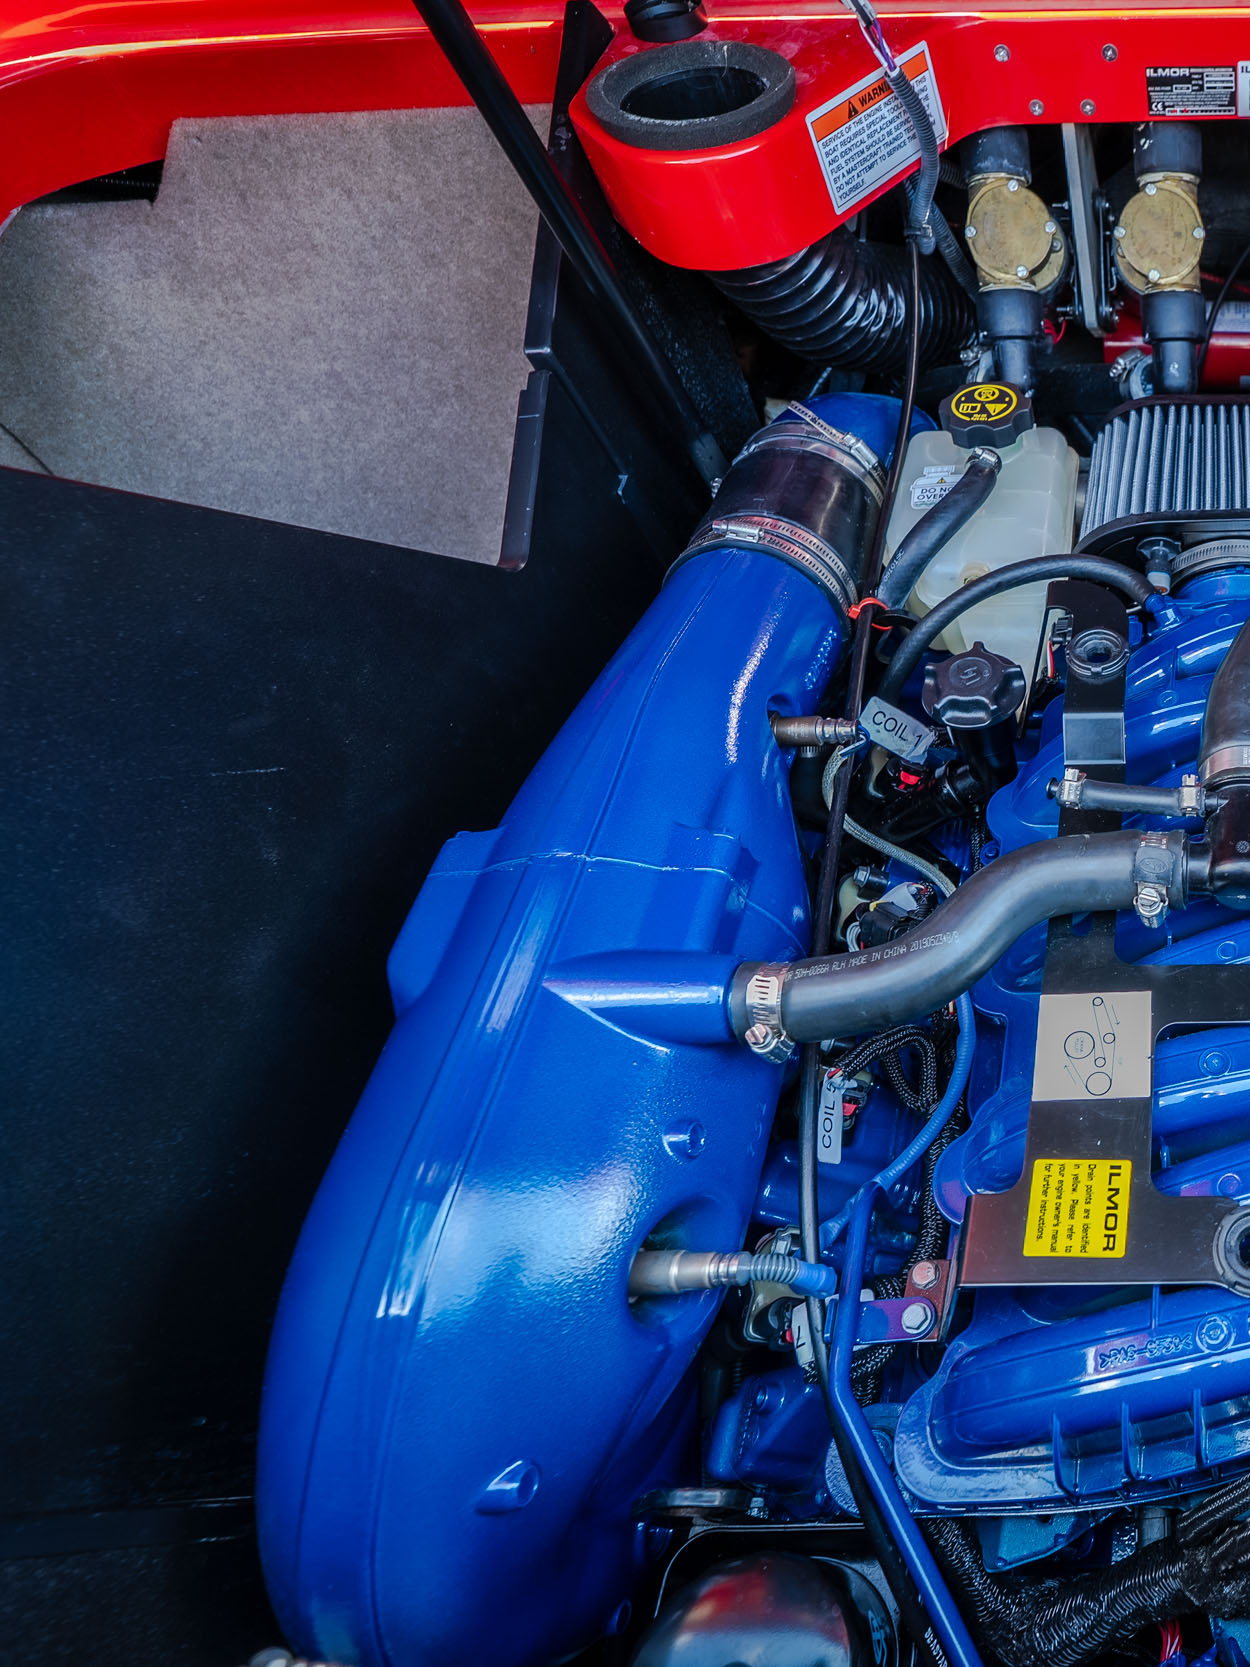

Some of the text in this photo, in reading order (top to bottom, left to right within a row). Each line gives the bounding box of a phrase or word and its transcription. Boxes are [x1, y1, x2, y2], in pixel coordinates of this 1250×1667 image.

[915, 75, 926, 87] THIS
[1146, 68, 1190, 77] ILMOR
[858, 79, 890, 107] WARNI
[821, 129, 844, 149] SERVICE
[844, 123, 853, 134] OF
[852, 117, 863, 128] THE
[863, 103, 883, 121] ENGINE
[824, 143, 839, 158] BOAT
[839, 125, 865, 148] REQUIRES
[865, 112, 886, 130] SPECIAL
[827, 154, 839, 167] AND
[839, 136, 865, 159] IDENTICAL
[866, 112, 901, 140] REPLACEMENT
[830, 162, 844, 176] FUEL
[844, 147, 865, 166] SYSTEM
[865, 134, 885, 152] SHOULD
[885, 128, 893, 138] BE
[893, 115, 911, 133] SERVIC
[833, 174, 841, 184] BY
[845, 146, 882, 176] MASTERCRAFT
[882, 131, 904, 150] TRAINED
[835, 182, 844, 193] DO
[844, 174, 855, 187] NOT
[855, 158, 878, 179] ATTEMPT
[879, 153, 886, 163] TO
[886, 139, 906, 158] SERVICE
[872, 710, 922, 747] COIL 1
[848, 954, 867, 968] MADE
[871, 951, 881, 962] IN
[884, 944, 907, 959] CHINA
[822, 1101, 835, 1149] COIL
[1044, 1163, 1053, 1171] for
[1087, 1164, 1096, 1180] Drain
[1041, 1174, 1051, 1197] further
[1083, 1185, 1094, 1204] points
[1049, 1163, 1065, 1252] your engine owner's manual
[1068, 1199, 1078, 1219] Please
[1102, 1165, 1122, 1251] ILMOR
[1066, 1224, 1075, 1240] refer
[1079, 1223, 1090, 1253] identified
